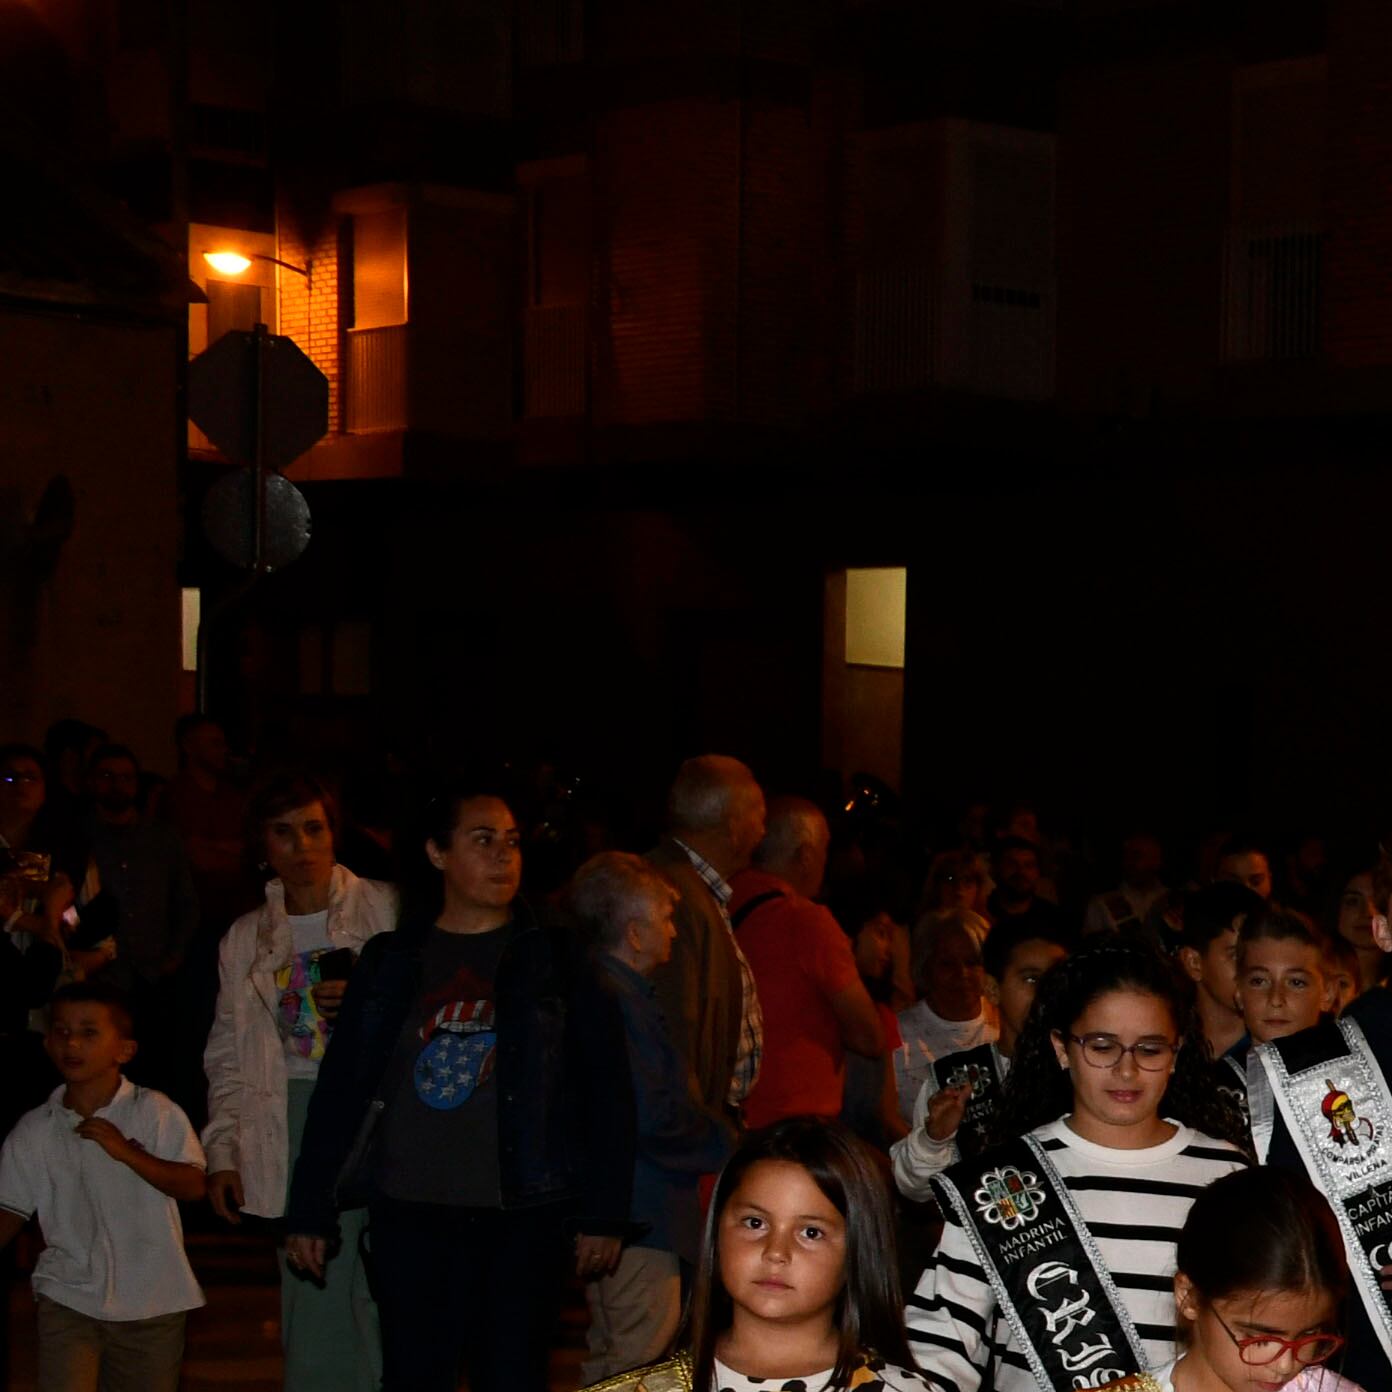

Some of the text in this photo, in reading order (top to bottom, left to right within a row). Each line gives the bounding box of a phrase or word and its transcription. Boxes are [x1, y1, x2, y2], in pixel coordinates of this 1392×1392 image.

[1345, 1159, 1388, 1181] VILLENA
[999, 1217, 1066, 1254] MADRINA
[1004, 1230, 1069, 1264] INFANTIL
